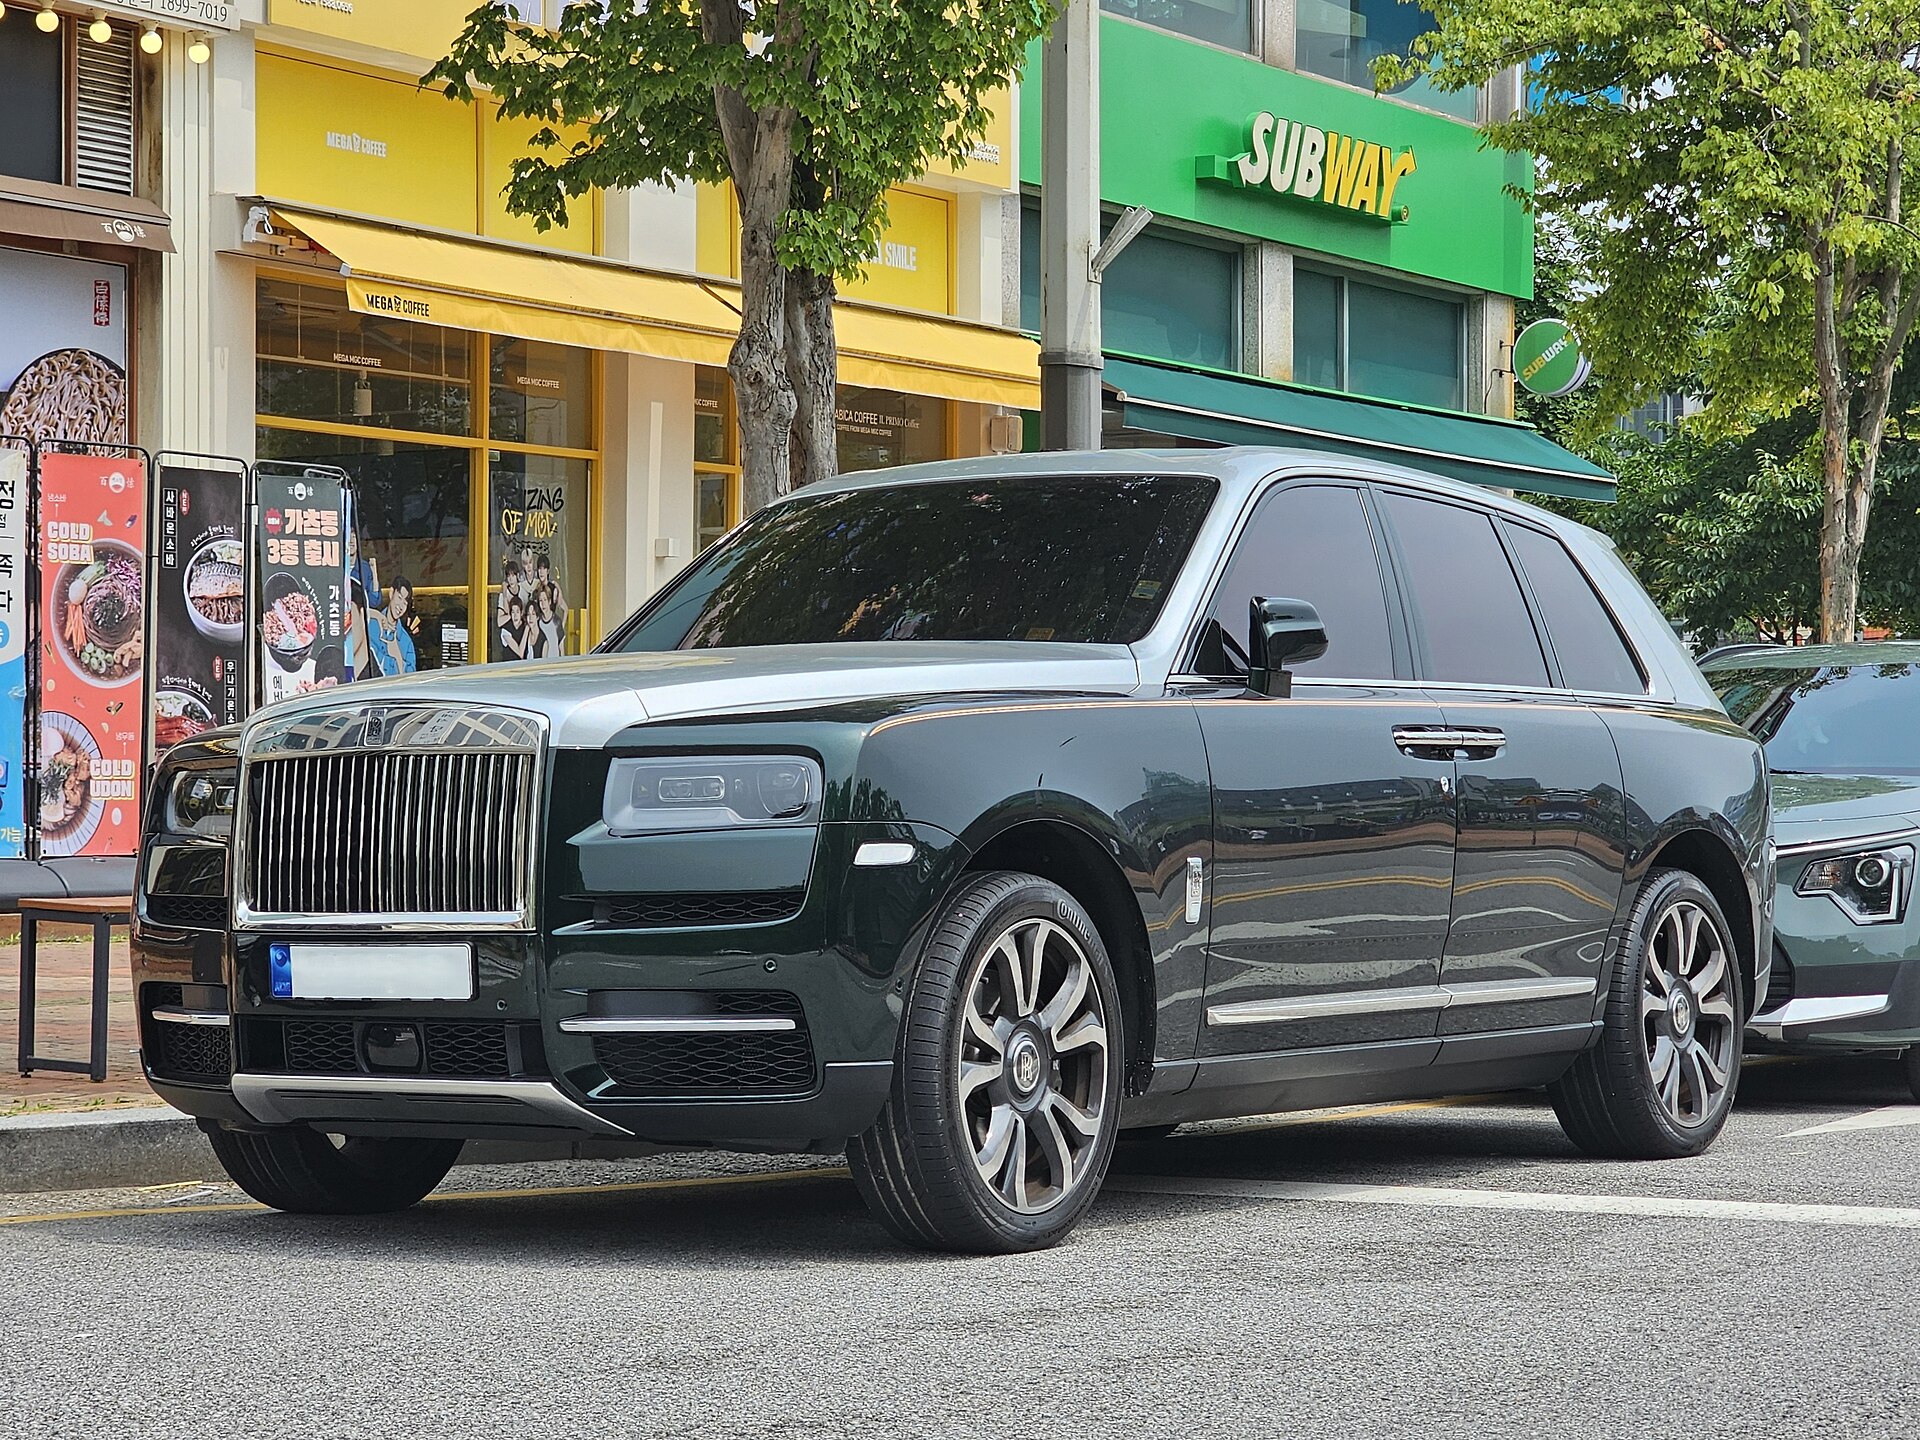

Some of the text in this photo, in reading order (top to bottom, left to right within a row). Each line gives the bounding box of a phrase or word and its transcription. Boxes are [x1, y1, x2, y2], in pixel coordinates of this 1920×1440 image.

[160, 0, 228, 22] 1899-7019
[326, 131, 387, 158] MEGA COFFEE
[1238, 111, 1417, 217] SUBWAY
[885, 241, 917, 272] SMILE
[365, 293, 430, 317] MEGA COFFEE
[333, 352, 350, 363] MEGA
[361, 356, 381, 367] COFFEE
[516, 376, 530, 385] MEGA
[541, 379, 560, 389] COFFEE
[702, 399, 718, 408] COFFEE
[854, 411, 878, 425] COFFEE
[47, 493, 67, 502] 냉소바
[47, 521, 93, 544] COLD
[165, 490, 175, 566] 사바온소바
[284, 508, 339, 537] 가츠동
[502, 508, 556, 538] OF MGC
[47, 542, 95, 564] SOBA
[267, 538, 340, 567] 3종 출시
[328, 585, 341, 637] 가츠동
[226, 661, 236, 724] 우나기온소
[115, 731, 135, 741] 냉우동
[89, 759, 135, 780] COLD
[89, 779, 135, 800] UDON
[0, 827, 22, 842] 가능
